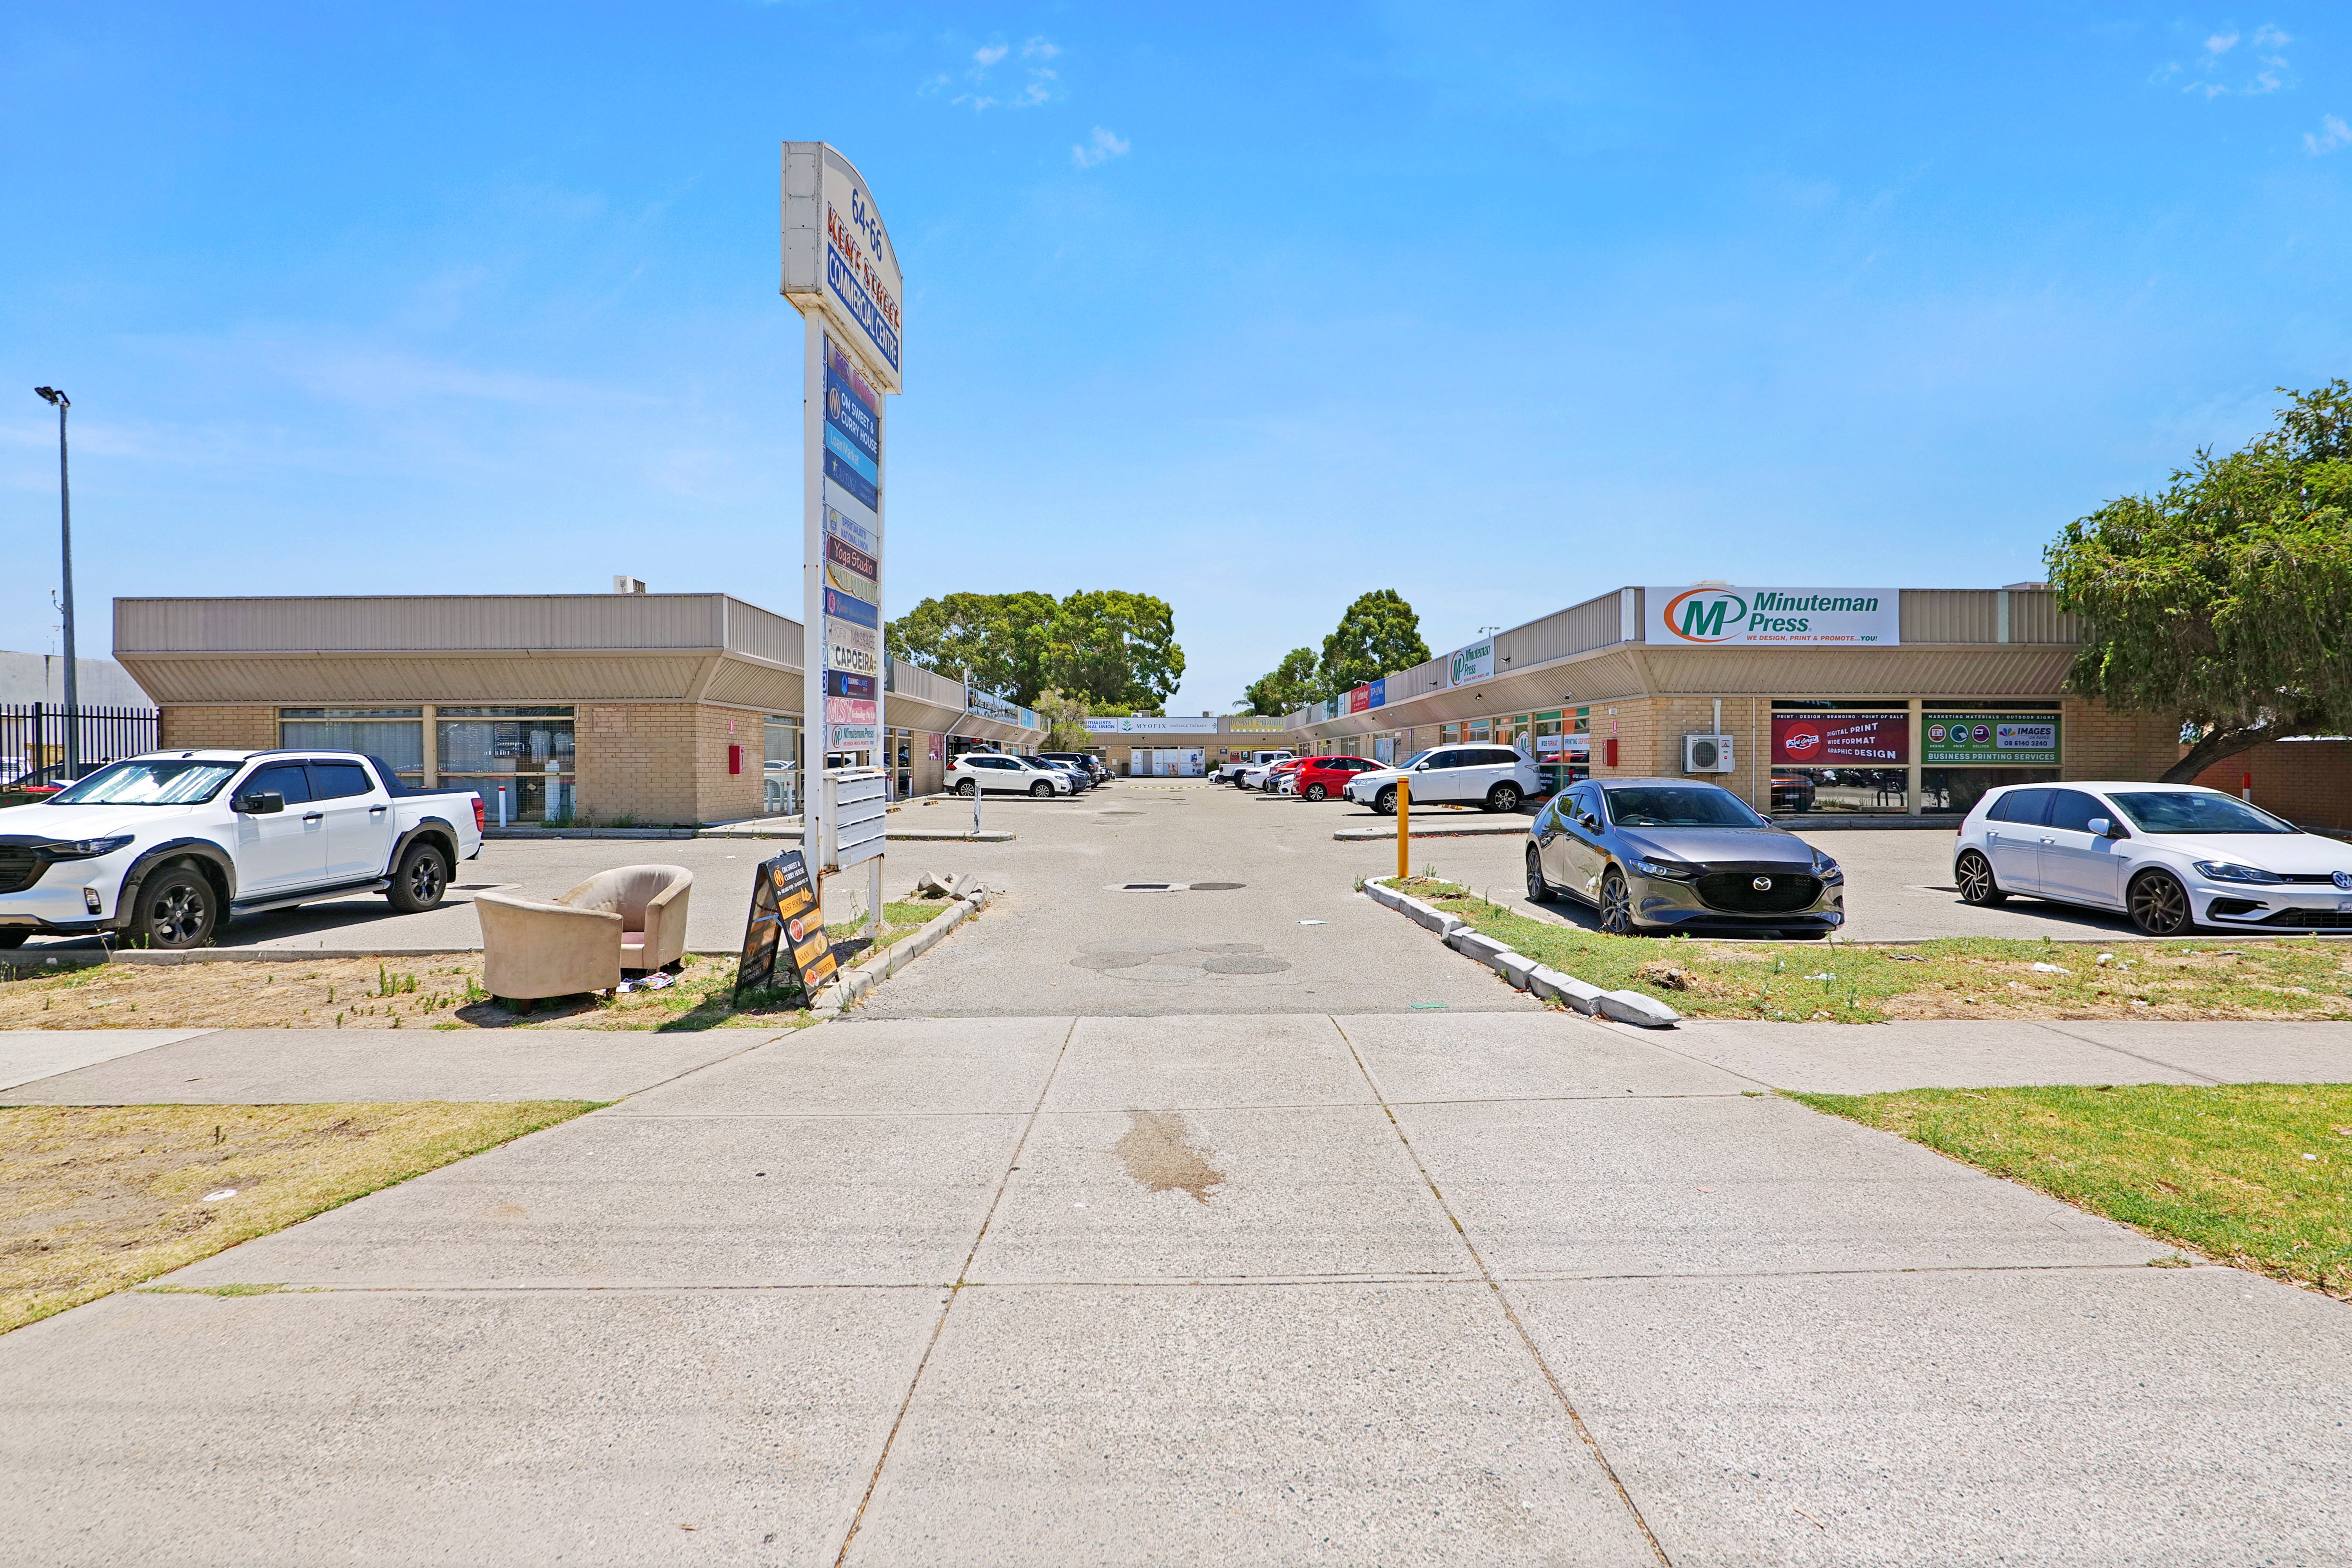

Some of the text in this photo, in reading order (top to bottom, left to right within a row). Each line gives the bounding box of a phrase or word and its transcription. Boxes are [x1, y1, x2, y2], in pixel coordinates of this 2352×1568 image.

[852, 188, 882, 261] 64-66
[827, 200, 900, 332] KENT STREET
[829, 252, 875, 338] COMMERCIAL
[875, 315, 897, 366] CENTRE
[841, 392, 874, 434] OM SWEET &
[841, 412, 877, 454] CURRY HOUSE
[830, 430, 859, 466] Loan Market
[841, 528, 868, 552] NATIONAL UNION
[834, 541, 873, 575] Yoga Studio
[1753, 592, 1879, 612] Minuteman
[1748, 613, 1809, 632] Press
[828, 624, 875, 650] MYOFIX MASSAGE
[836, 646, 874, 672] CAPOEIRA
[1465, 645, 1490, 662] Minuteman
[1464, 664, 1476, 676] Press
[1370, 684, 1384, 697] TP-LINK
[826, 697, 853, 722] MSY
[844, 728, 864, 739] Minuteman
[864, 728, 874, 738] Press
[1850, 722, 1878, 733] PRINT
[1855, 749, 1896, 759] DESIGN
[782, 898, 803, 914] FAST FOOD
[806, 915, 818, 927] CURRY
[798, 950, 809, 962] NAAN
[818, 962, 832, 976] SWEETS
